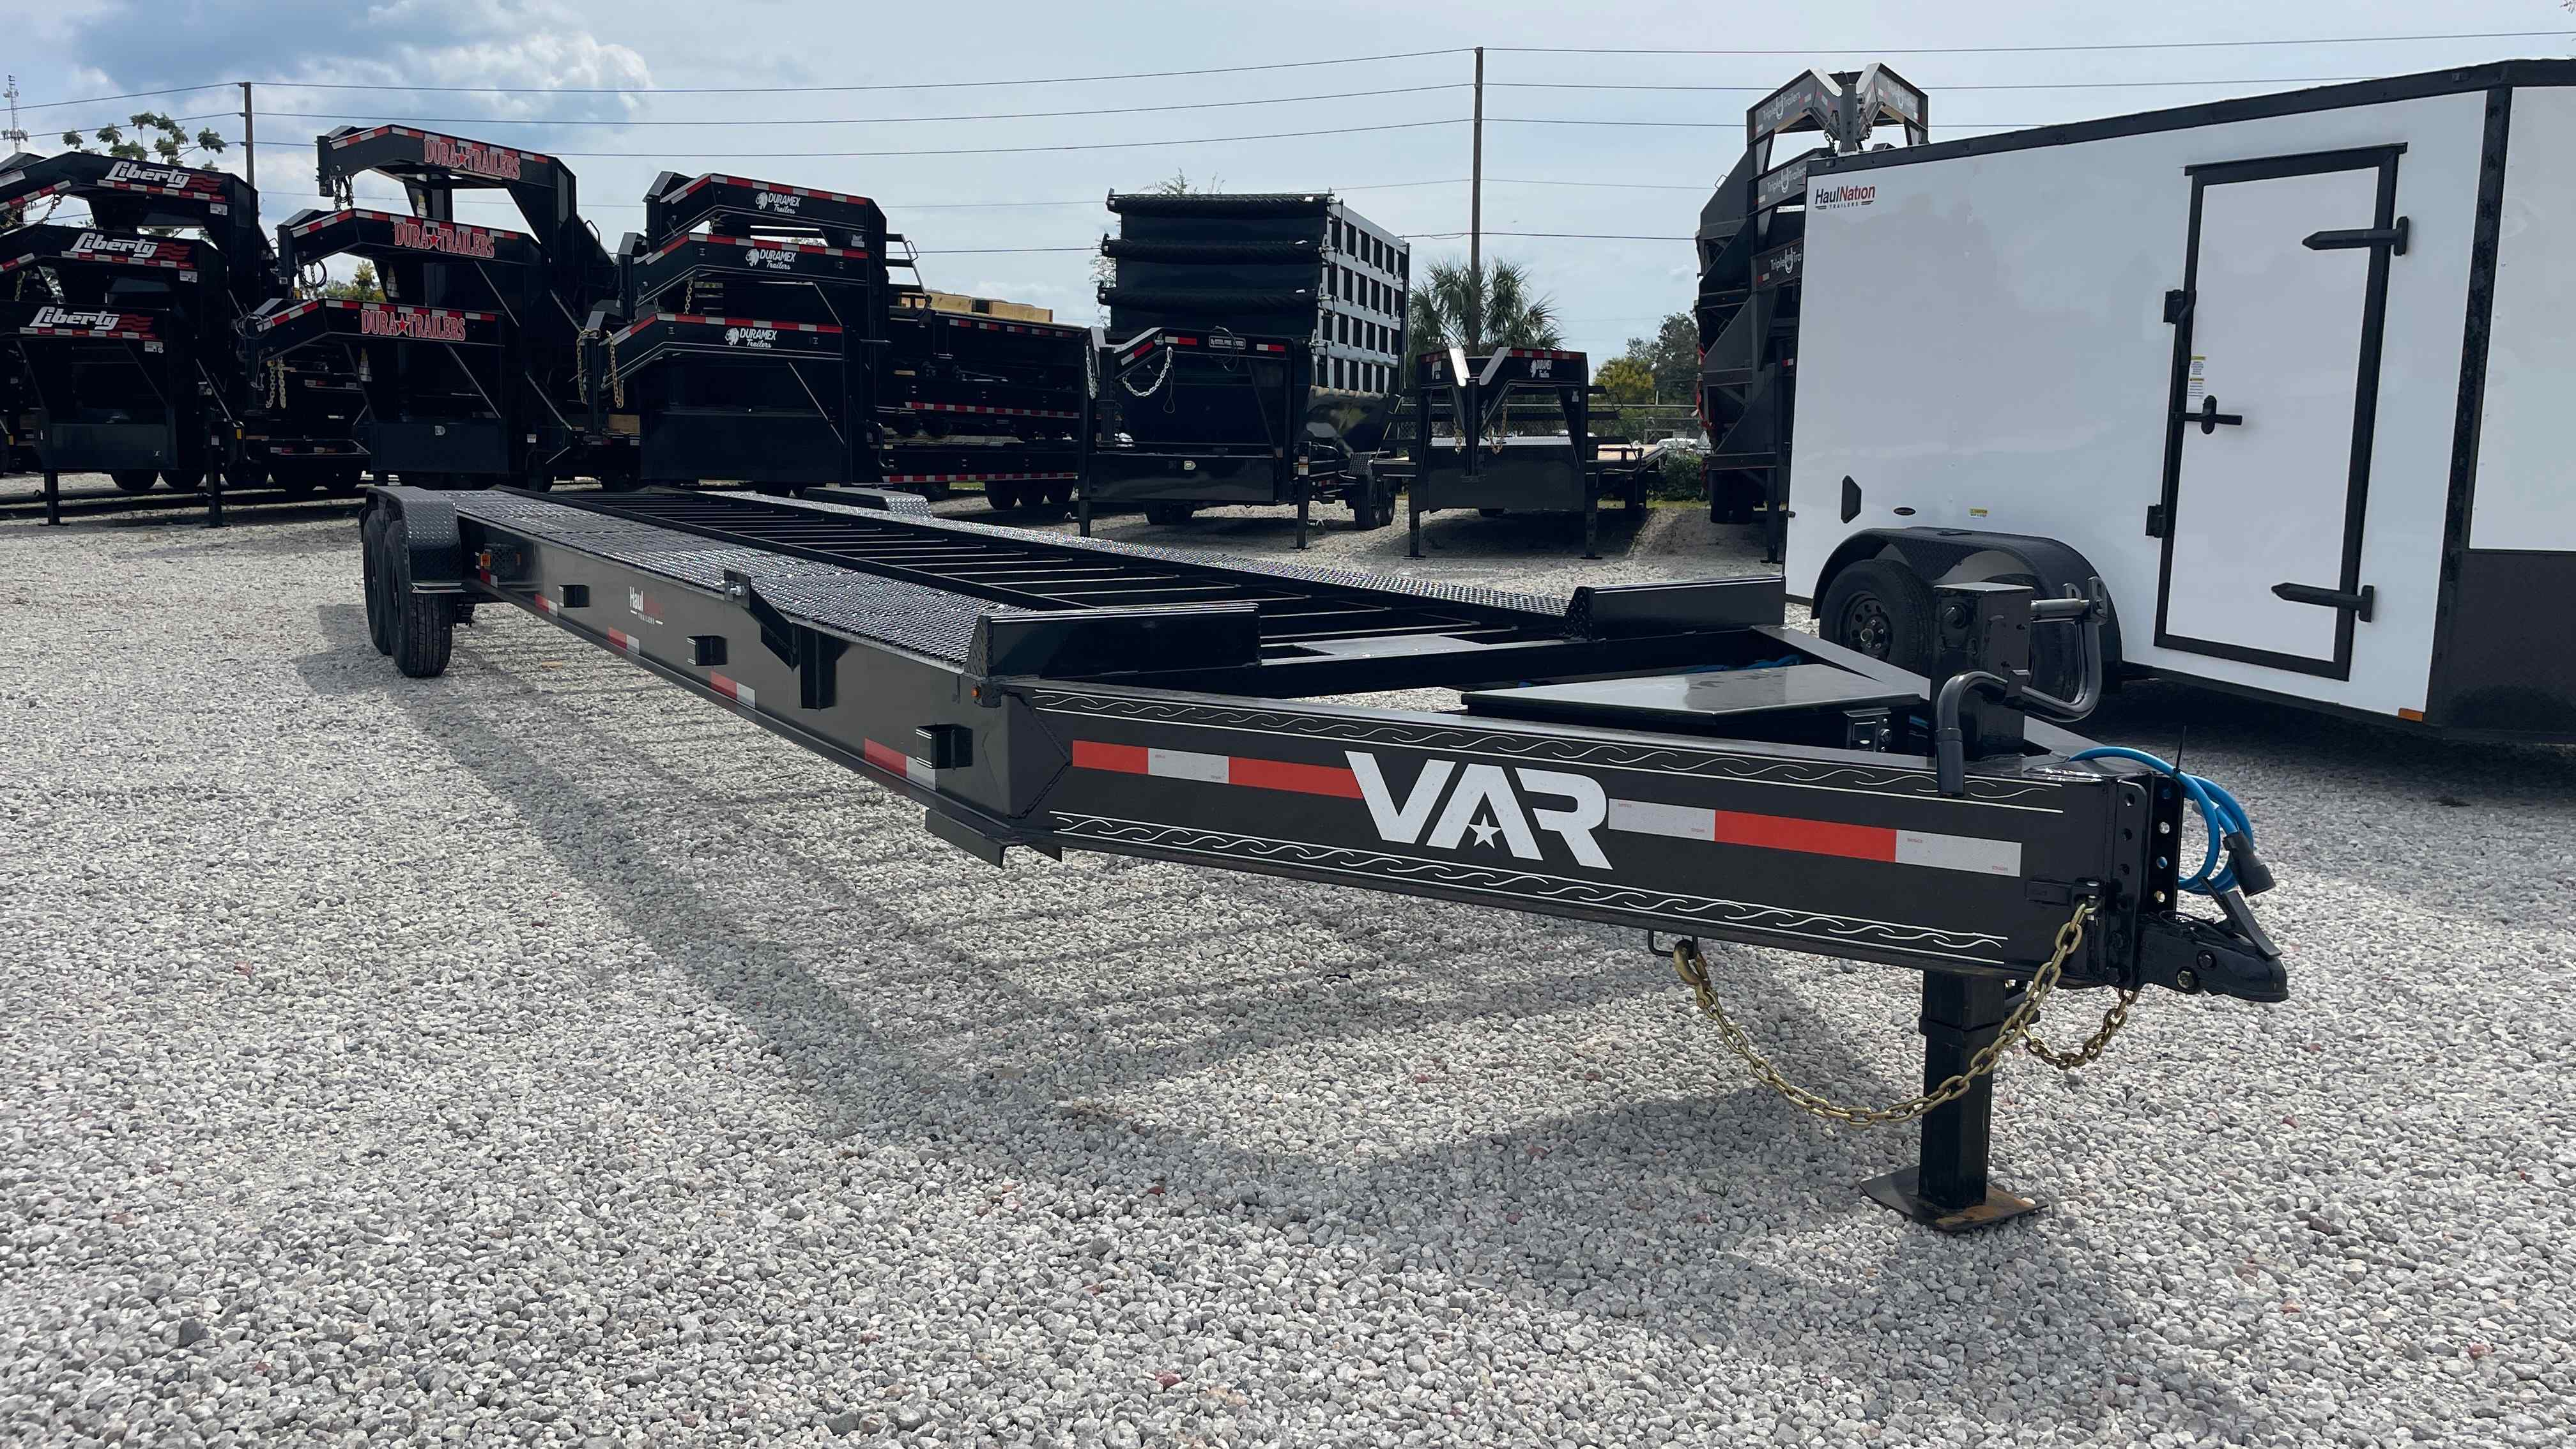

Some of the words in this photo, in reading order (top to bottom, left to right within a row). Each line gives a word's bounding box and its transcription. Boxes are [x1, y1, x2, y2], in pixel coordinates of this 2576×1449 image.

[424, 139, 457, 166] DURA
[466, 149, 521, 181] TRAILERS
[105, 160, 190, 188] Liberty
[768, 193, 801, 207] DURAMEX
[1814, 185, 1876, 204] HaulNation
[774, 203, 795, 214] Trailers
[70, 232, 158, 257] Liberty
[394, 222, 429, 252] DURA
[438, 227, 494, 258] TRAILERS
[760, 249, 796, 263] DURAMEX
[767, 259, 791, 270] Trailers
[29, 306, 120, 330] Liberty
[361, 309, 397, 336] DURA
[408, 313, 465, 341] TRAILERS
[739, 328, 777, 341] DURAMEX
[746, 339, 772, 348] Trailers
[1344, 750, 1613, 870] VAR
